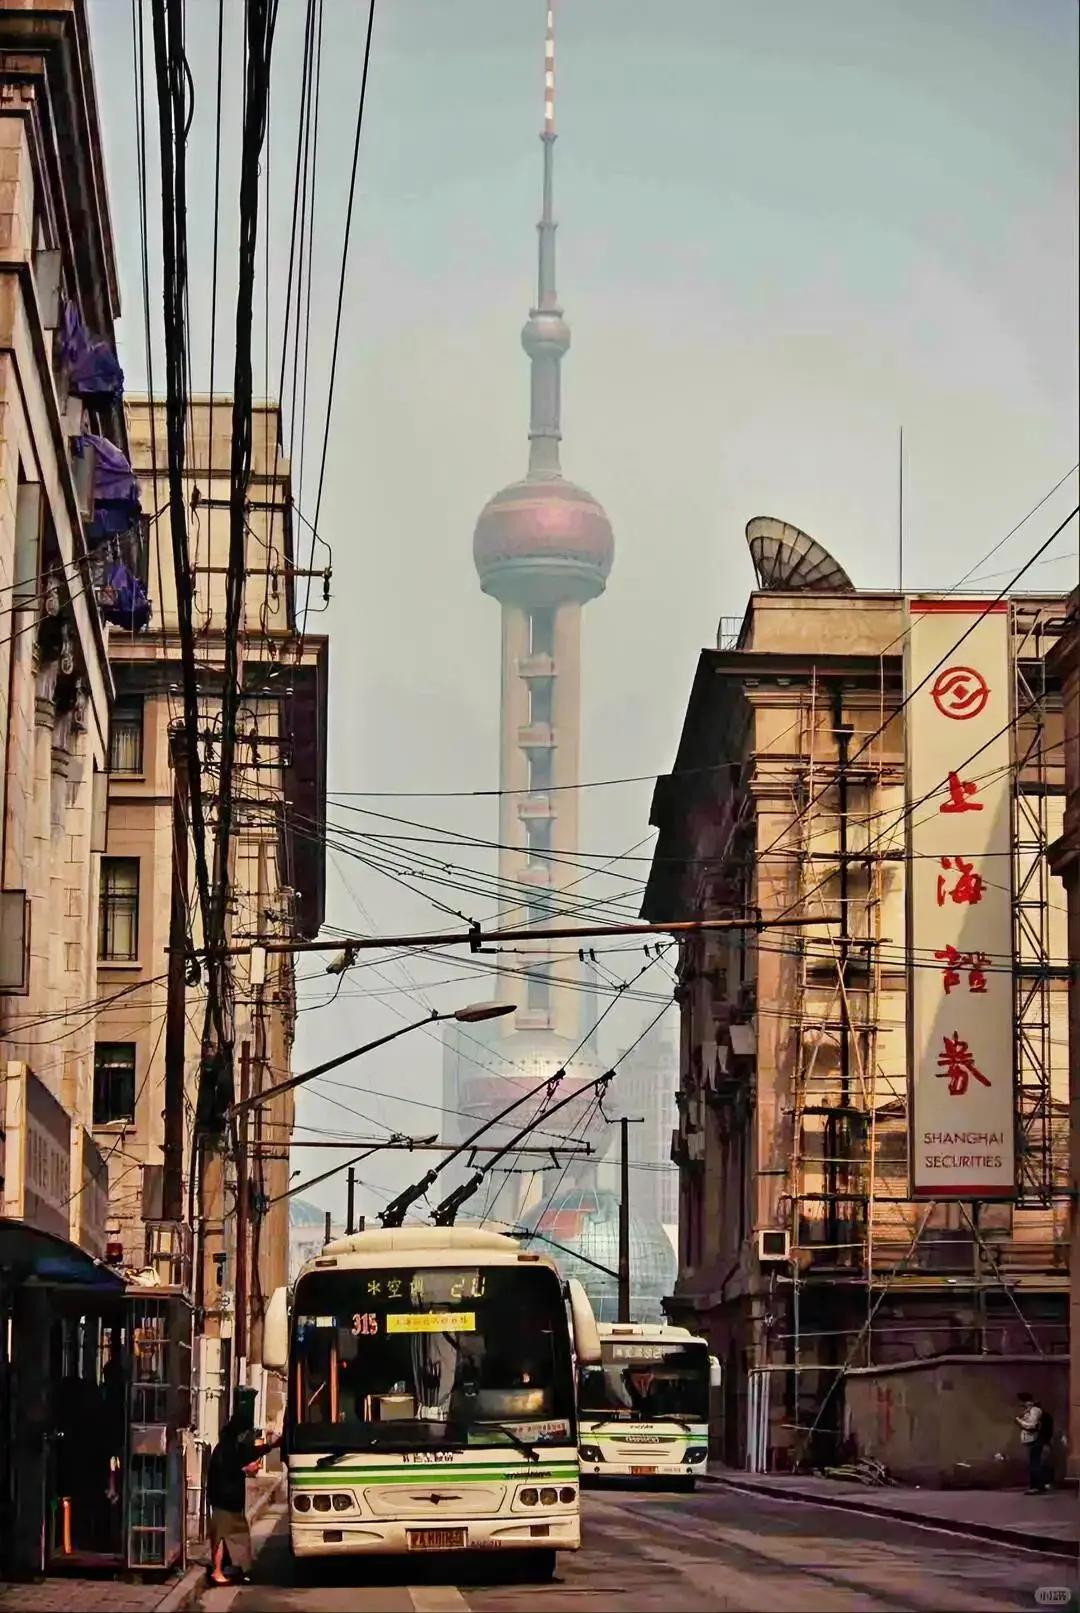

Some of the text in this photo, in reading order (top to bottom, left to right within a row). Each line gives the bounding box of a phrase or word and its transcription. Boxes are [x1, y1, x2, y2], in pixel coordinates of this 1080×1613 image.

[923, 1131, 1004, 1146] SHANGHAI
[925, 1154, 1002, 1169] SECURITIES
[351, 1312, 378, 1336] 315
